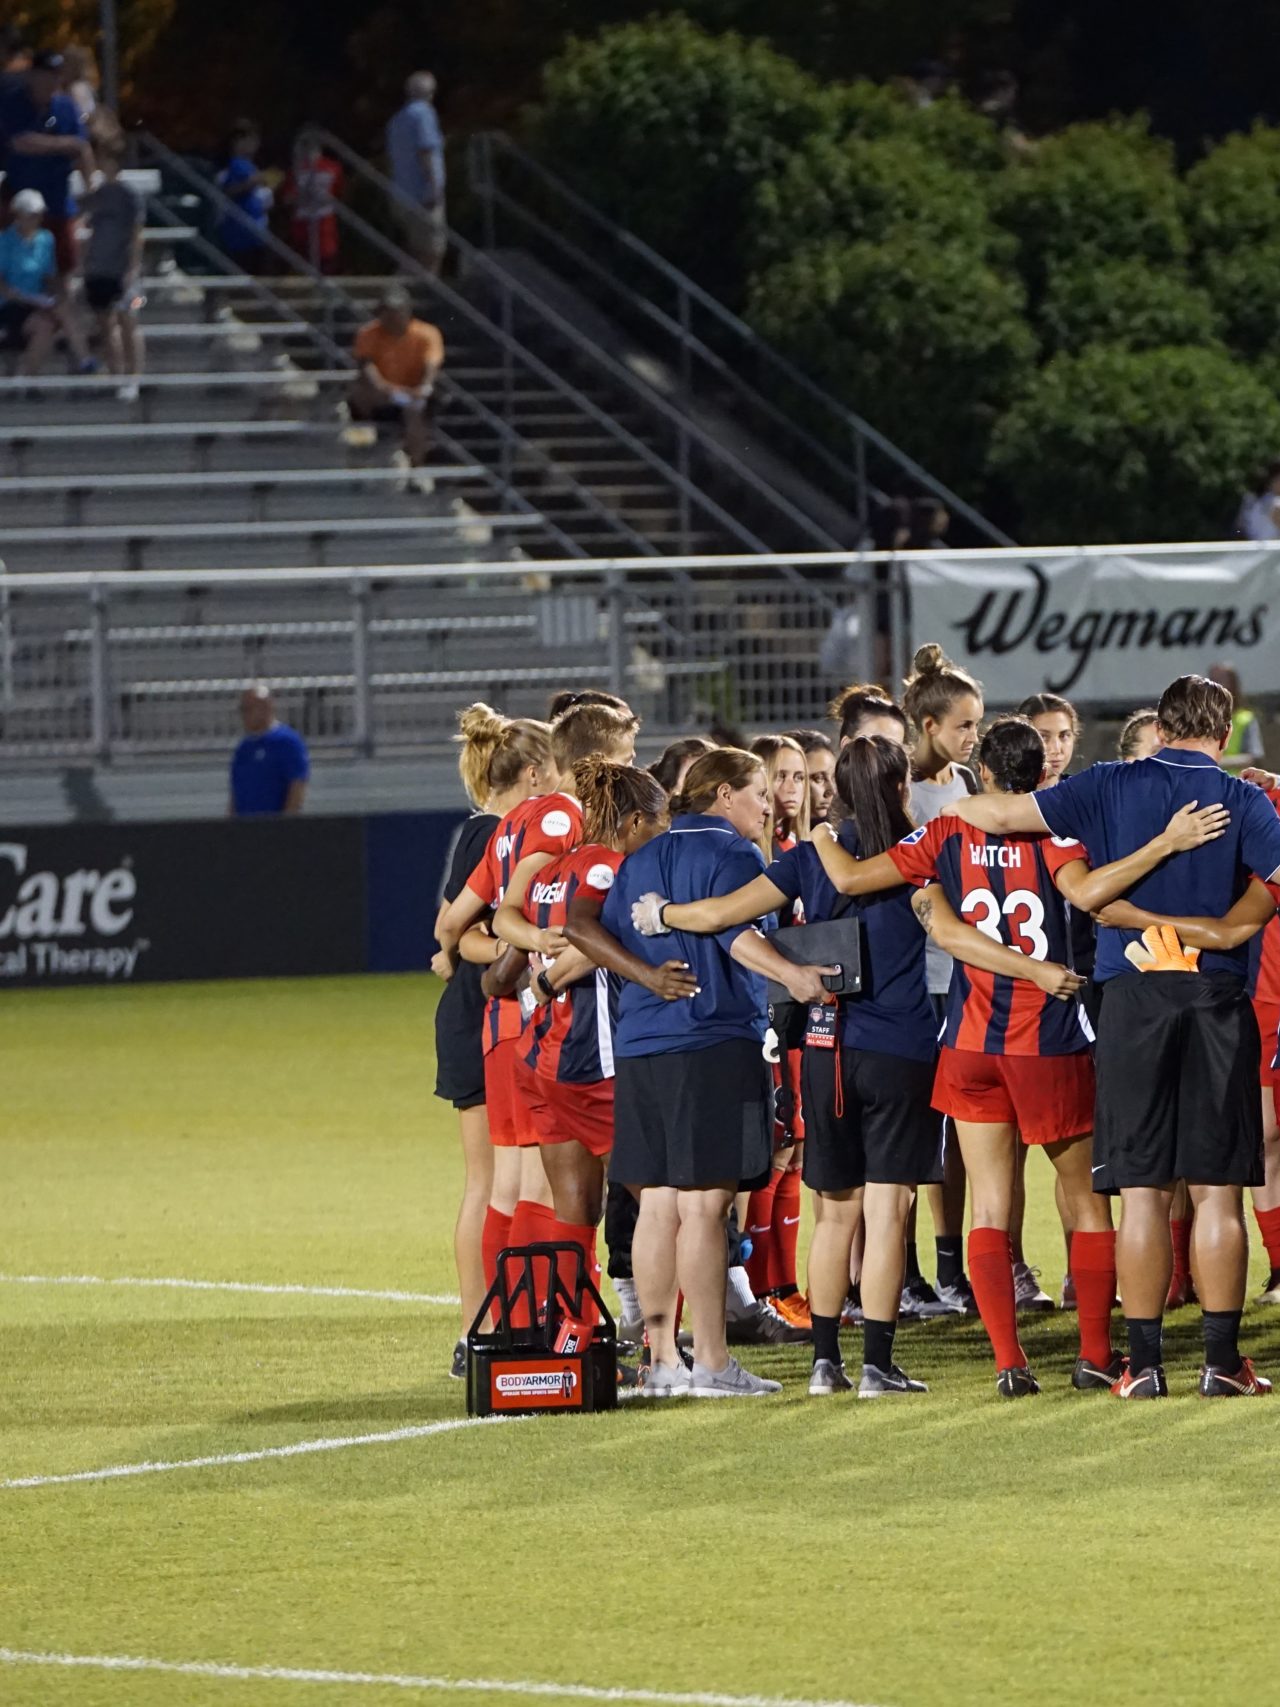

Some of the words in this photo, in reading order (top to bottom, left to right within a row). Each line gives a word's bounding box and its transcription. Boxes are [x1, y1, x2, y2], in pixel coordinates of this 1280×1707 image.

[953, 563, 1268, 693] Wegmans
[961, 888, 1048, 961] 33
[31, 942, 139, 978] Therapy
[811, 1025, 830, 1034] STAFF
[501, 1374, 561, 1387] BODYARMOR
